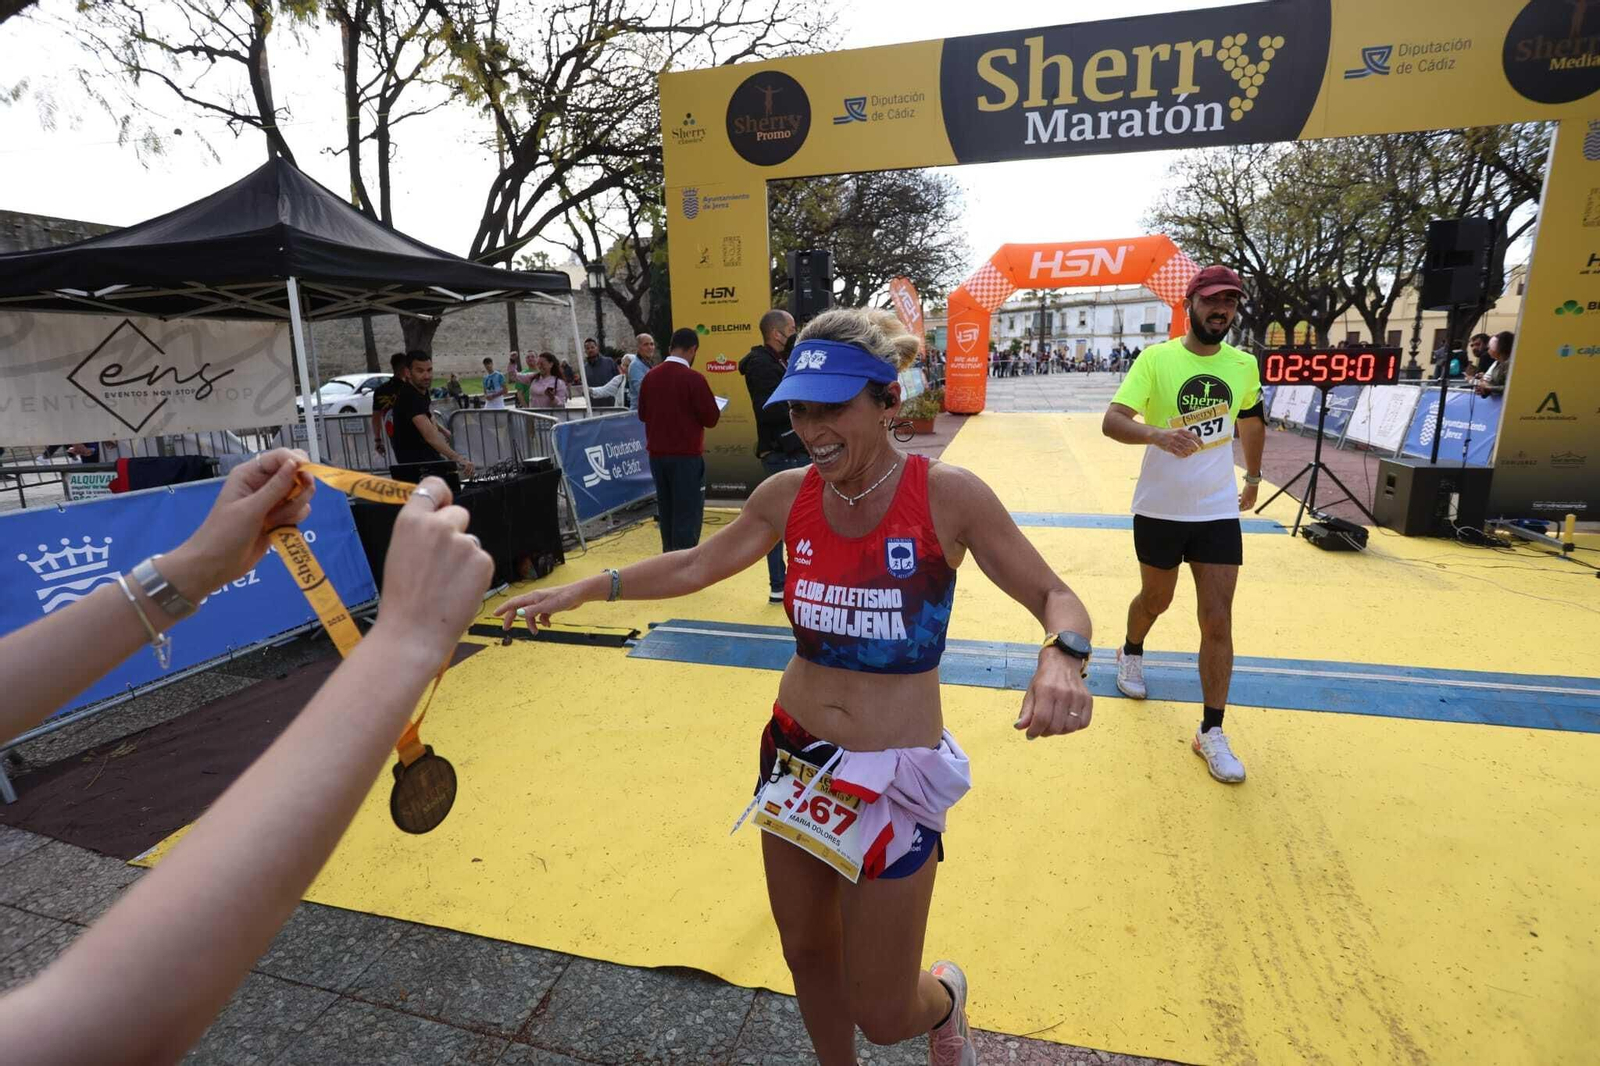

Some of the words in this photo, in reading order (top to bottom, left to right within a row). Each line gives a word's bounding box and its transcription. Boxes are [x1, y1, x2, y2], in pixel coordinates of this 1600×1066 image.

[1397, 38, 1472, 57] Diputación
[1396, 62, 1412, 74] de
[1418, 57, 1457, 72] Cádiz
[977, 33, 1285, 121] Sherry
[871, 91, 925, 107] Diputación
[734, 113, 801, 134] Sherry
[871, 111, 885, 121] de
[887, 108, 915, 120] Cádiz
[1024, 92, 1225, 145] Maratón
[756, 129, 791, 141] Promo
[702, 194, 750, 203] Ayuntamiento
[1029, 246, 1127, 279] HSN
[704, 287, 735, 299] HSN
[711, 324, 751, 332] BELCHIM
[1265, 354, 1395, 382] 02:59:01
[99, 362, 235, 401] ens
[1182, 394, 1224, 406] Sherr
[1185, 410, 1212, 421] Sherry
[605, 438, 642, 458] Diputación
[612, 466, 622, 479] de
[622, 459, 641, 476] Cádiz
[71, 475, 115, 484] ALQUIVA
[360, 480, 416, 501] herry
[278, 532, 316, 585] Sherry
[795, 579, 824, 602] CLUB
[824, 584, 902, 609] ATLETISMO
[793, 599, 907, 640] TREBUJENA
[784, 779, 858, 836] 367
[789, 814, 811, 828] MARIA
[811, 824, 841, 847] DOLORES
